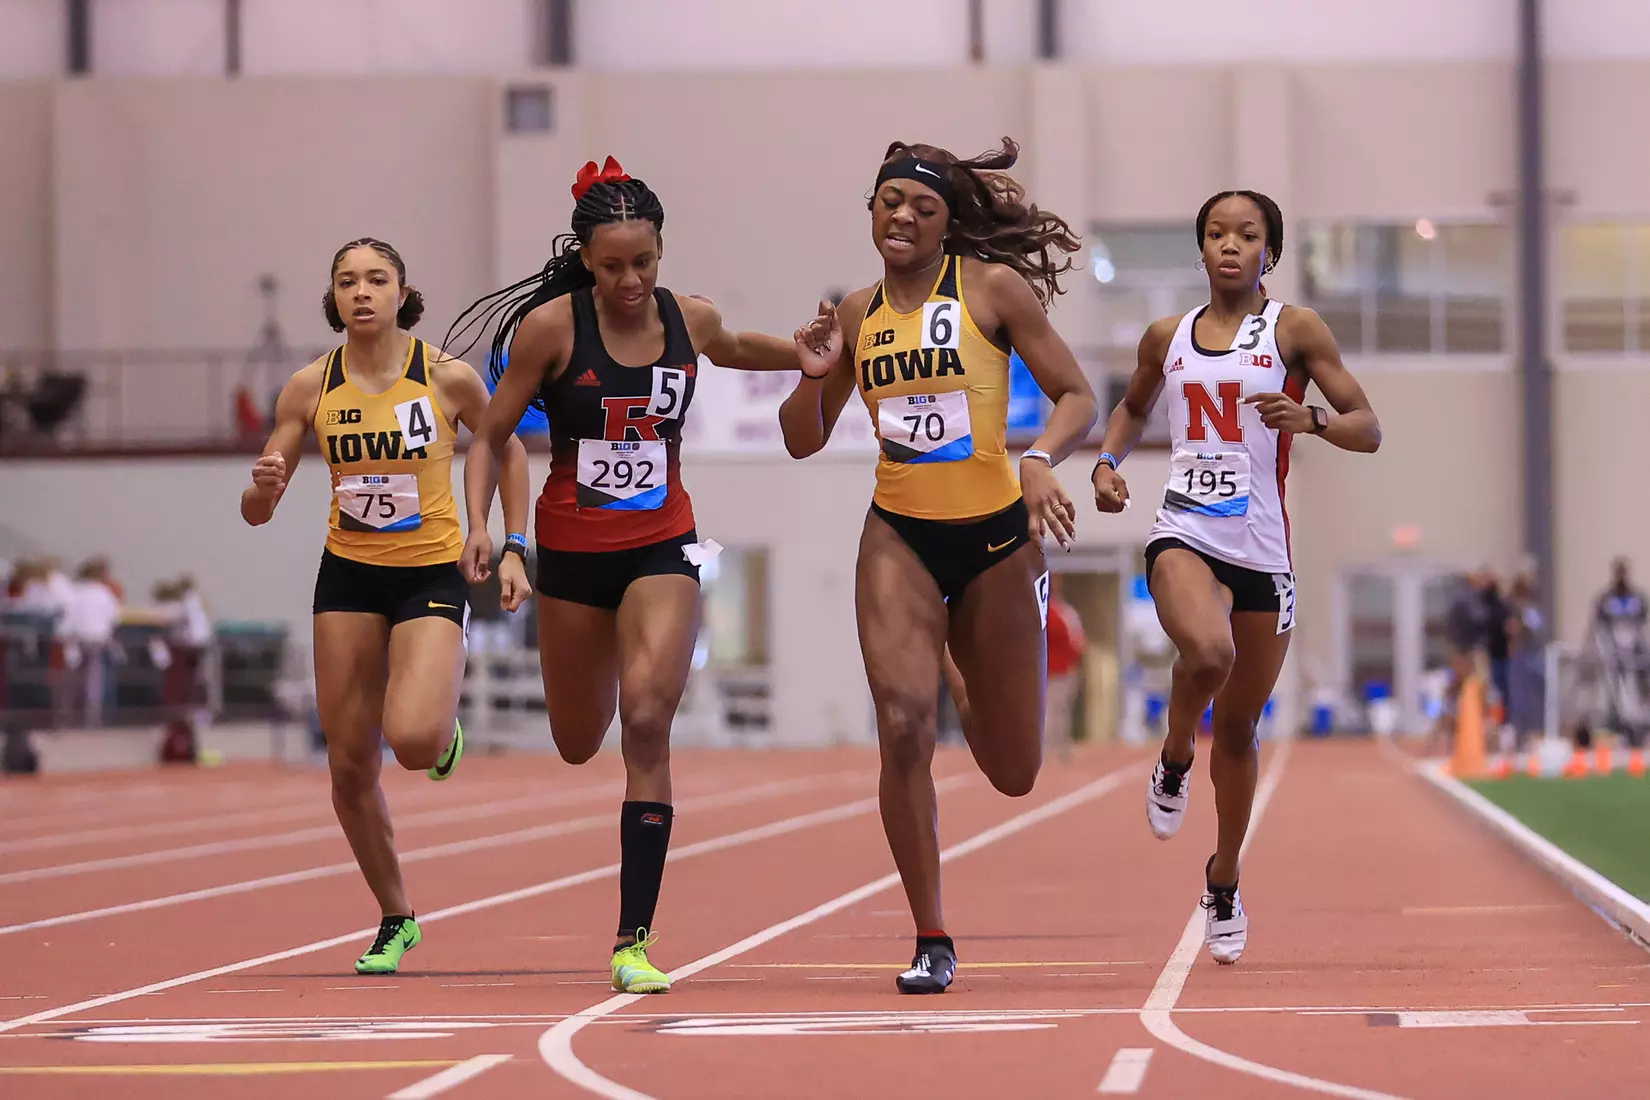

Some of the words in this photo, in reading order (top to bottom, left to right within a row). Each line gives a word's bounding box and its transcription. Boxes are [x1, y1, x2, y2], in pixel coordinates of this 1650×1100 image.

[930, 303, 952, 346] 6
[1238, 316, 1267, 350] 3
[861, 348, 966, 392] IOWA
[655, 371, 679, 416] 5
[1181, 379, 1245, 444] N
[408, 401, 432, 443] 4
[601, 396, 667, 441] R
[903, 412, 945, 443] 70
[591, 460, 654, 489] 292
[1184, 468, 1237, 497] 195
[356, 493, 396, 518] 75
